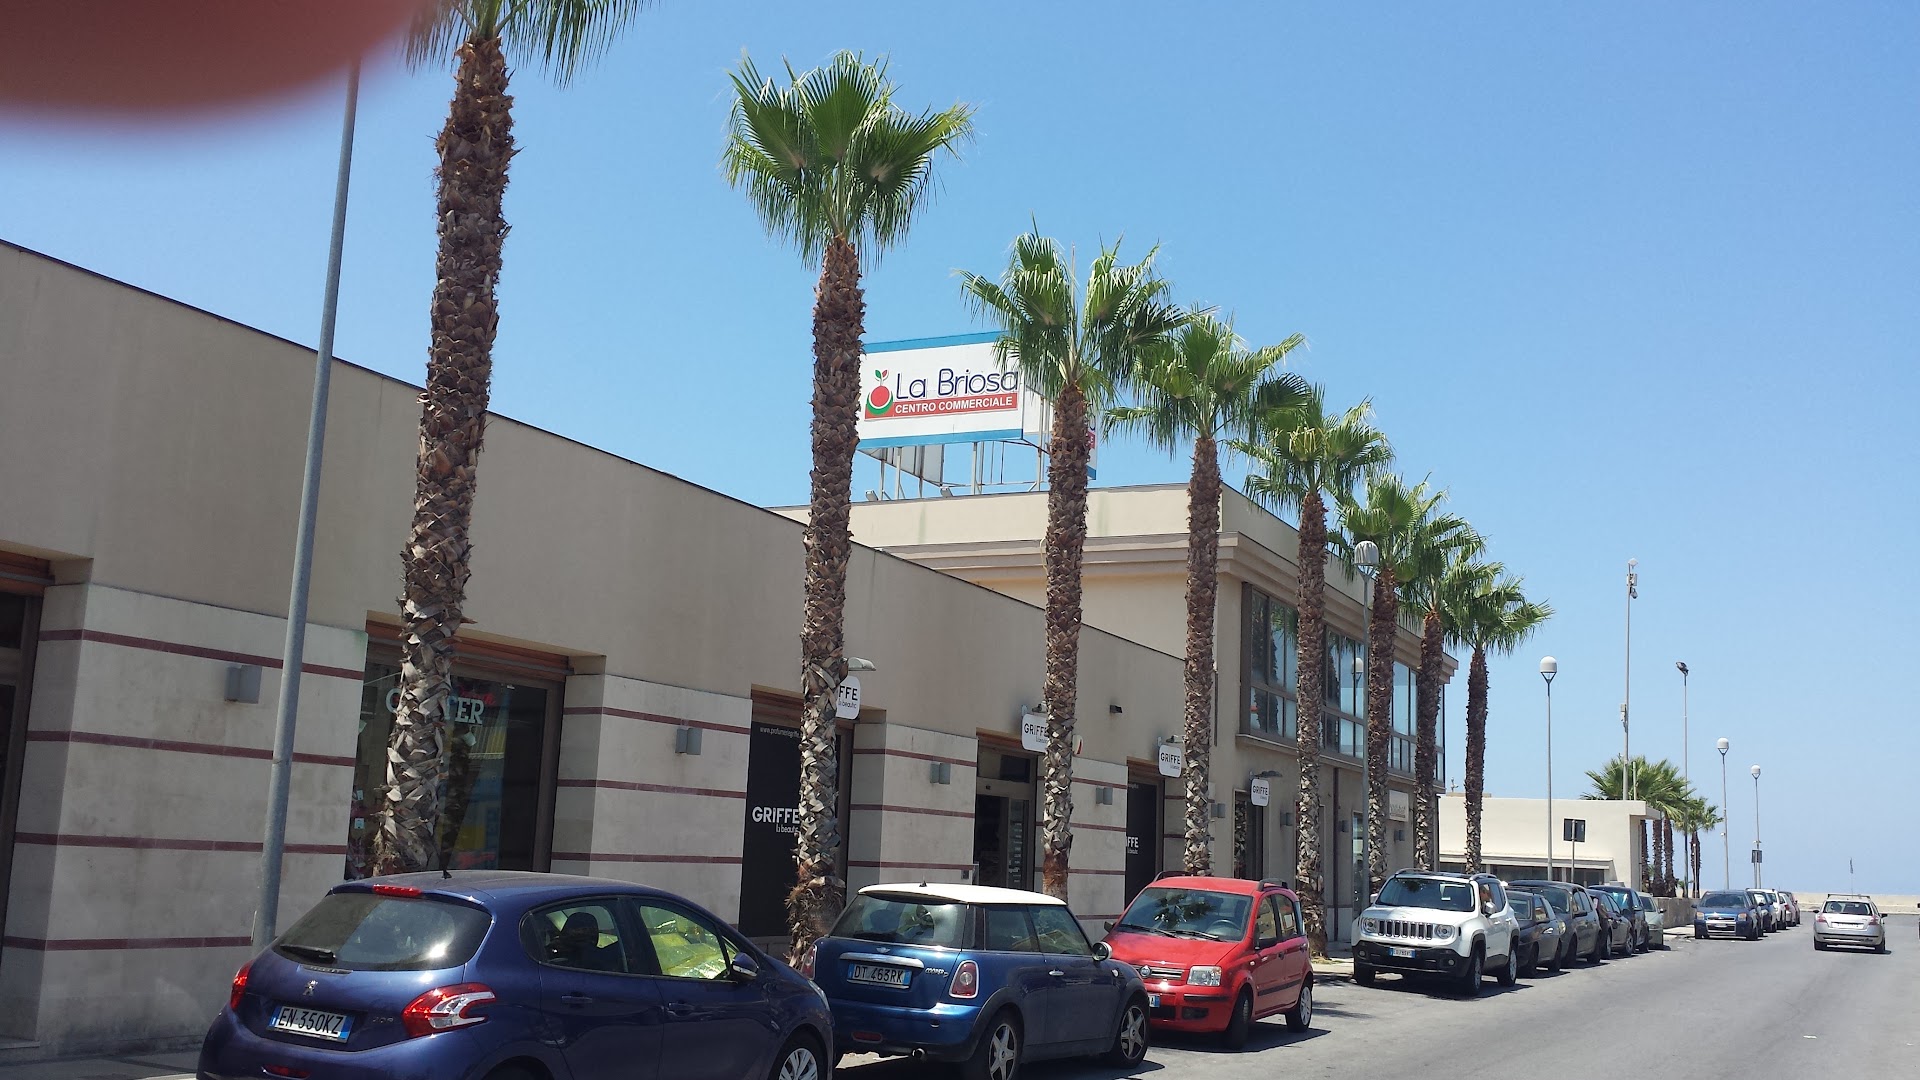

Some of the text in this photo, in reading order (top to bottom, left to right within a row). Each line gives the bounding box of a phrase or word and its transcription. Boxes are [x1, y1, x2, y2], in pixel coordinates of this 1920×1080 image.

[896, 368, 1018, 399] La Briosa
[895, 396, 1013, 414] CENTRO COMMERCIALE
[839, 685, 858, 701] FFE
[1160, 752, 1181, 765] GRIFFE
[1252, 785, 1268, 796] GRIFFE
[752, 806, 800, 824] GRIFFE
[854, 965, 905, 984] DT 463RK
[278, 1007, 344, 1035] EN 350KZ
